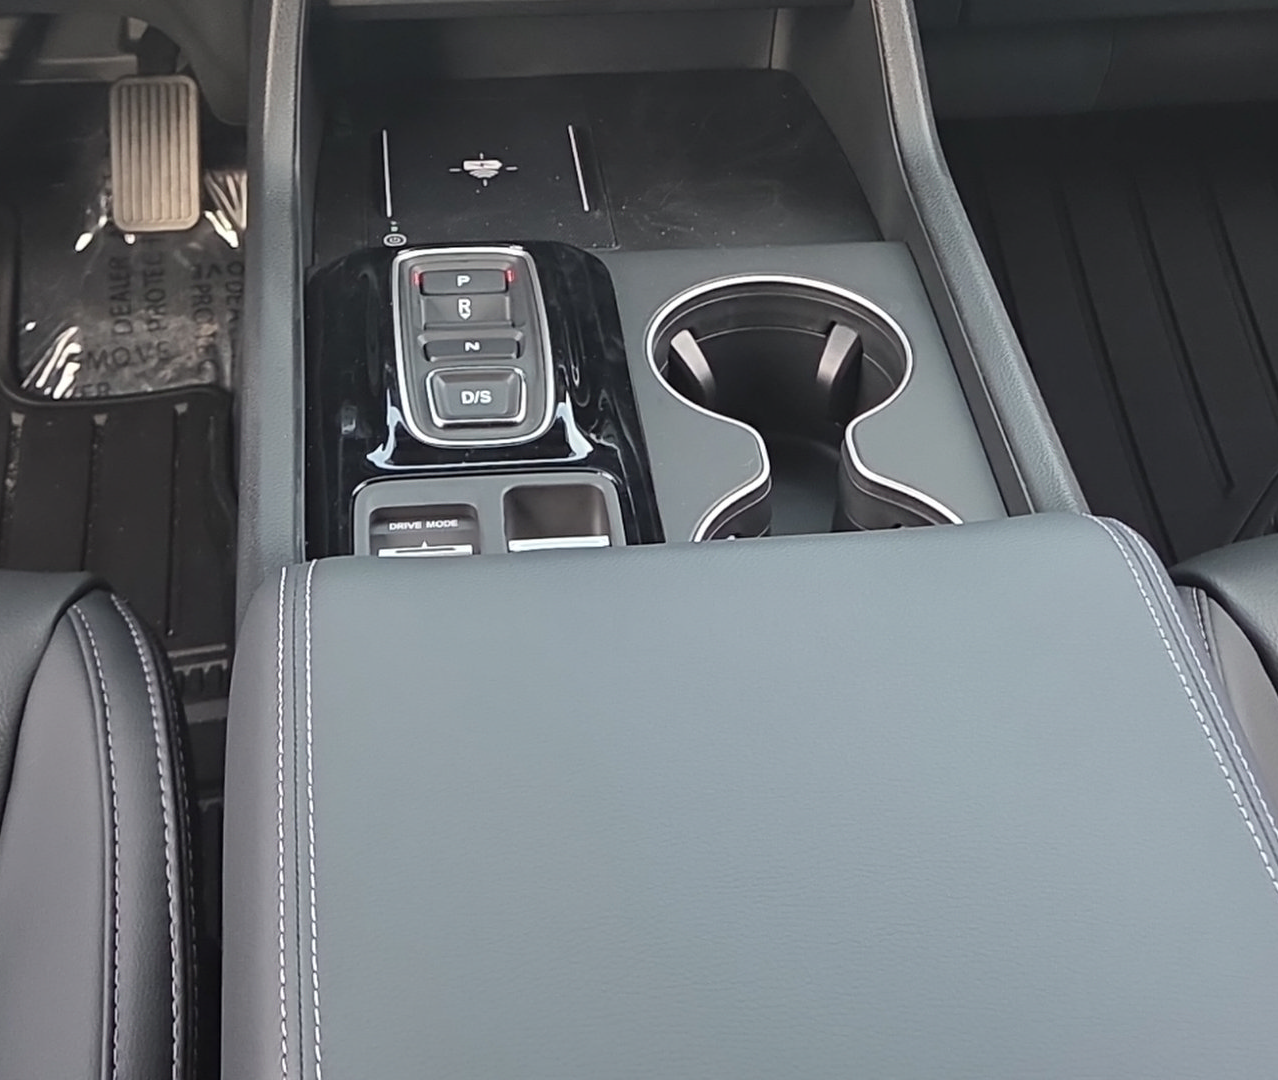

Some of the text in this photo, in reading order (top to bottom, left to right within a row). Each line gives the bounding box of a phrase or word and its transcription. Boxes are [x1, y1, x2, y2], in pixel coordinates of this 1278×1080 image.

[456, 275, 471, 287] P
[108, 255, 133, 337] DEALER
[457, 298, 472, 312] R
[464, 341, 481, 352] N
[460, 389, 493, 405] D/S
[388, 519, 459, 531] DRIVE MODE
